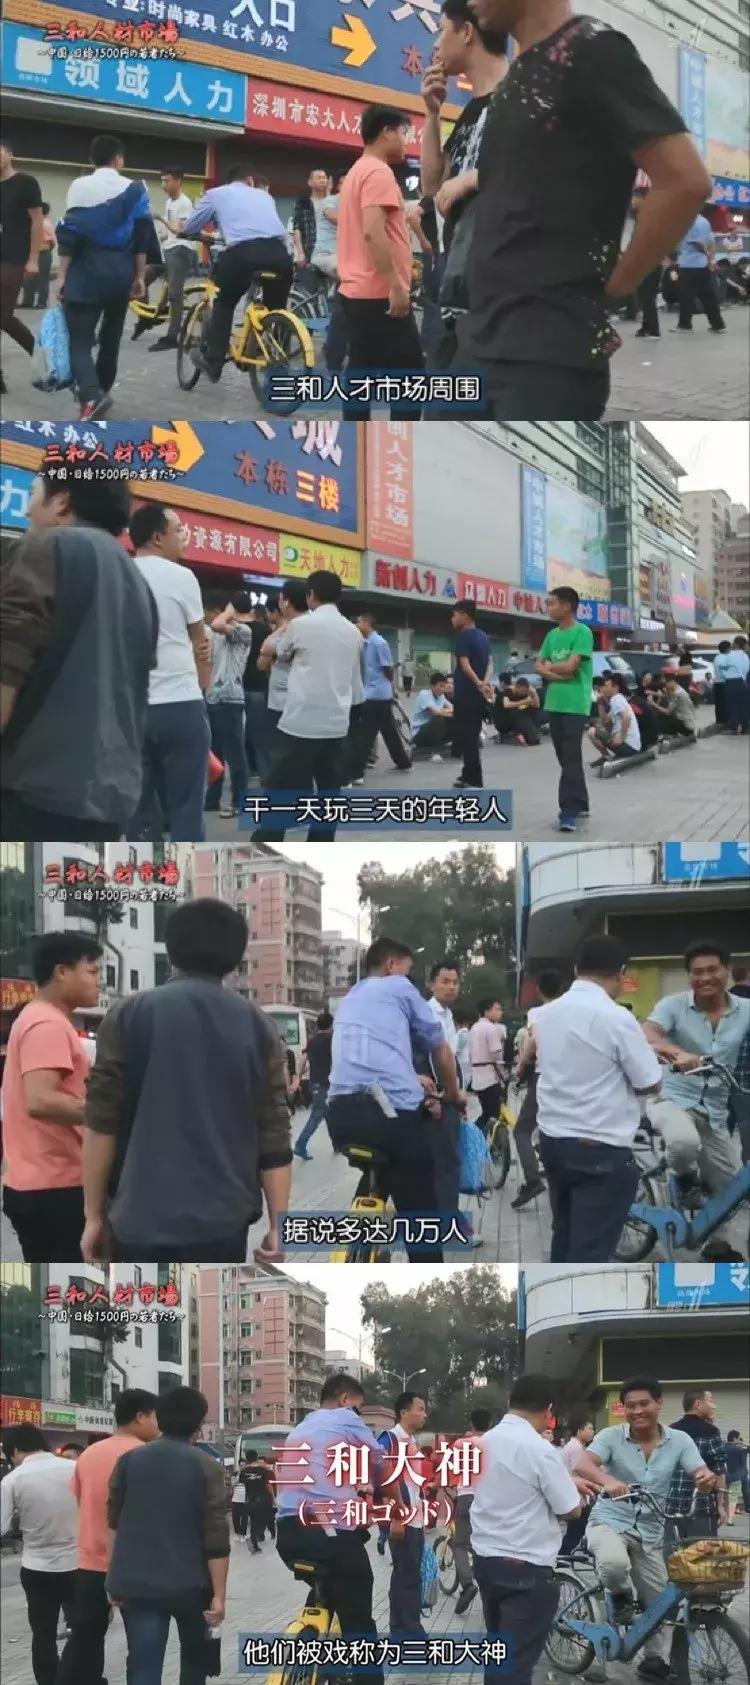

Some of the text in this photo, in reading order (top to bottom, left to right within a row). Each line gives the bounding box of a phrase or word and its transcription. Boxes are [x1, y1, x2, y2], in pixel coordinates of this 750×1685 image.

[223, 19, 255, 42] 红木
[260, 30, 289, 52] 办公
[64, 54, 234, 114] 领域人力
[0, 479, 29, 517] 力
